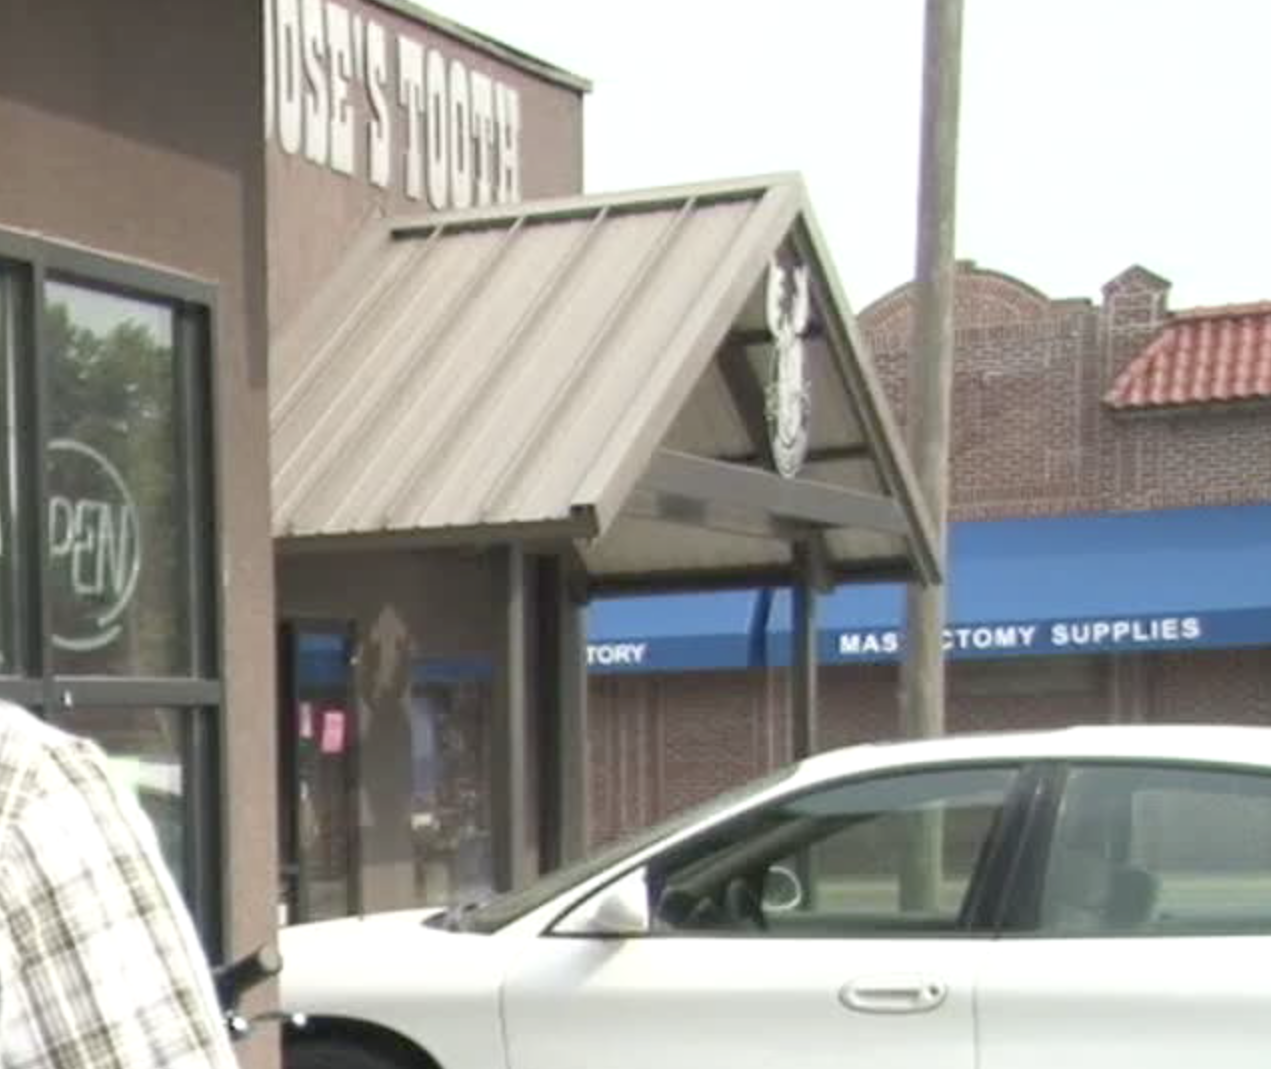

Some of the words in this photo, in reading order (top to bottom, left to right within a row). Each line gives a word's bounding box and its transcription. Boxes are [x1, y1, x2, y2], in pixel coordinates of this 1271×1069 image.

[396, 36, 521, 210] TOOTH
[48, 497, 130, 596] PEN
[840, 624, 1036, 654] MASCTOMY
[1051, 617, 1202, 645] SUPPLIES
